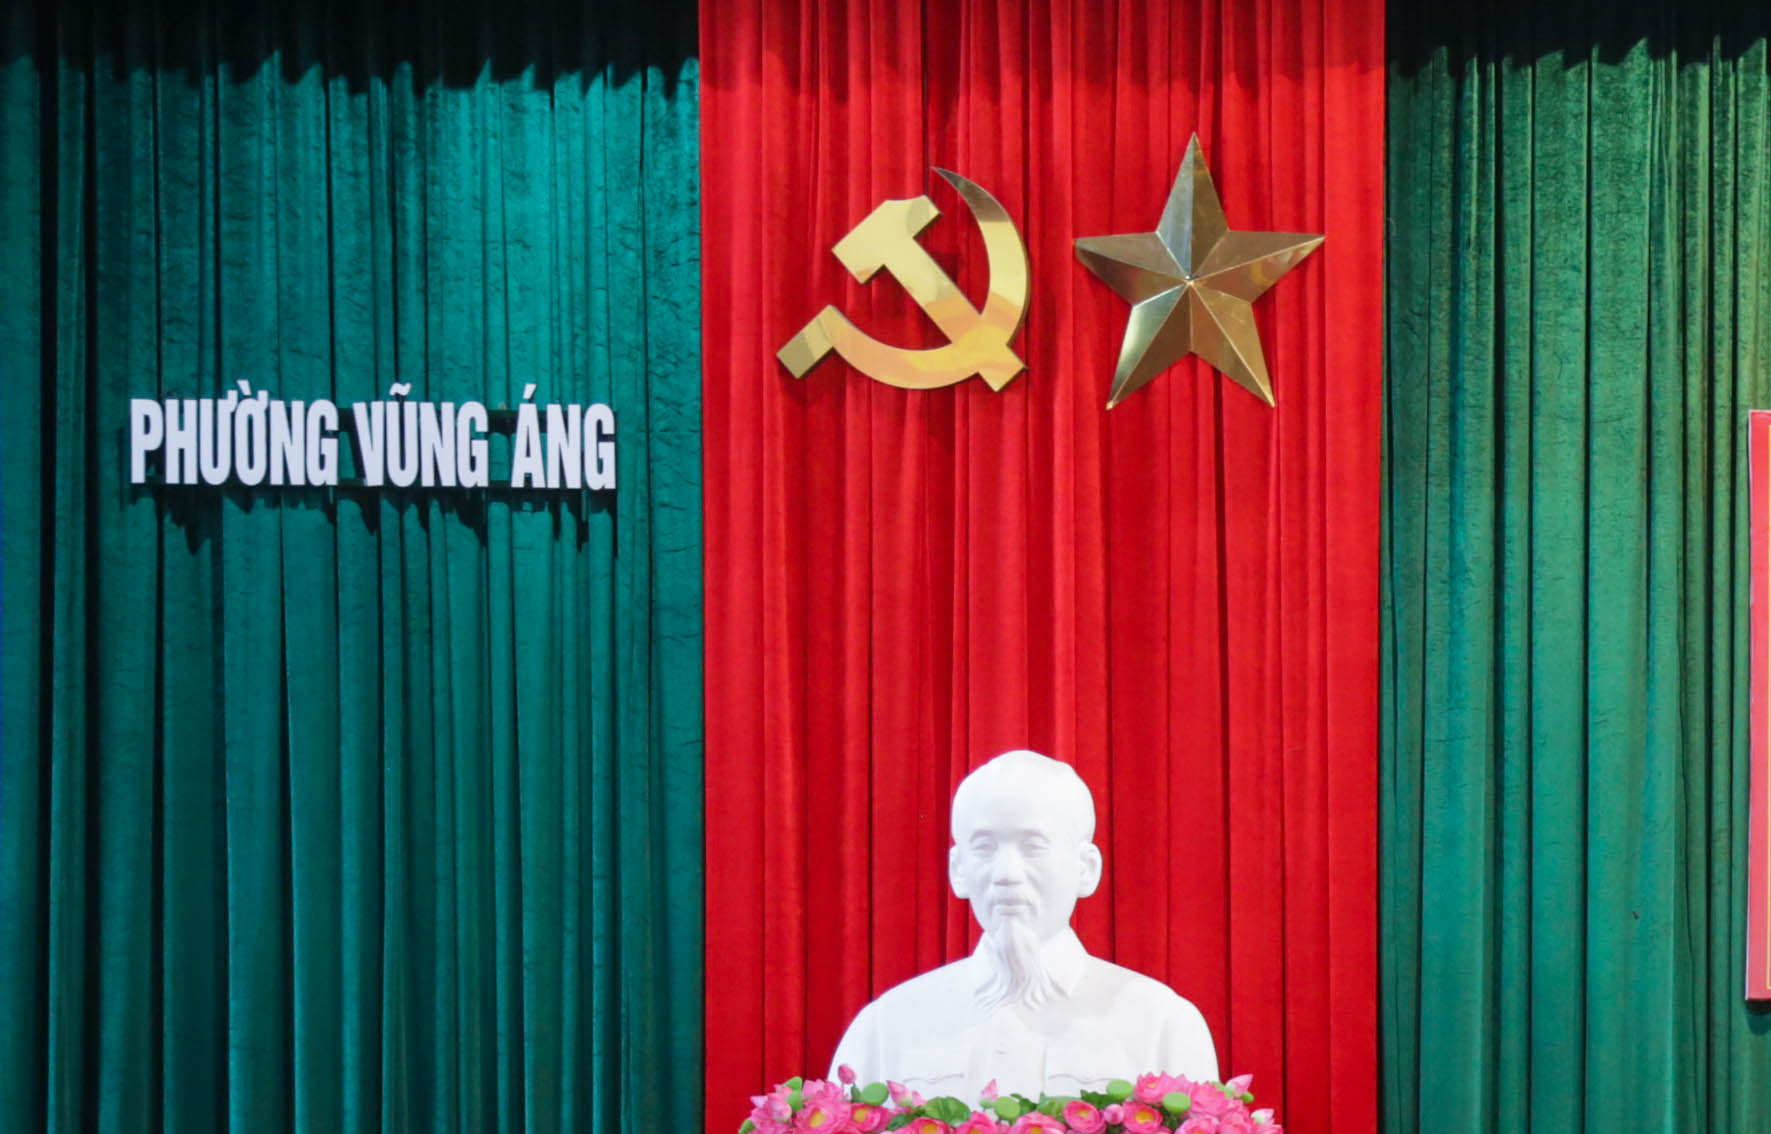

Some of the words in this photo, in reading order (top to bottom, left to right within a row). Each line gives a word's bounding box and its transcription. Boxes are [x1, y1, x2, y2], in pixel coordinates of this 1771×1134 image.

[131, 380, 338, 486] PHƯỜNG
[354, 383, 489, 488] VŨNG
[511, 383, 616, 490] ÁNG
